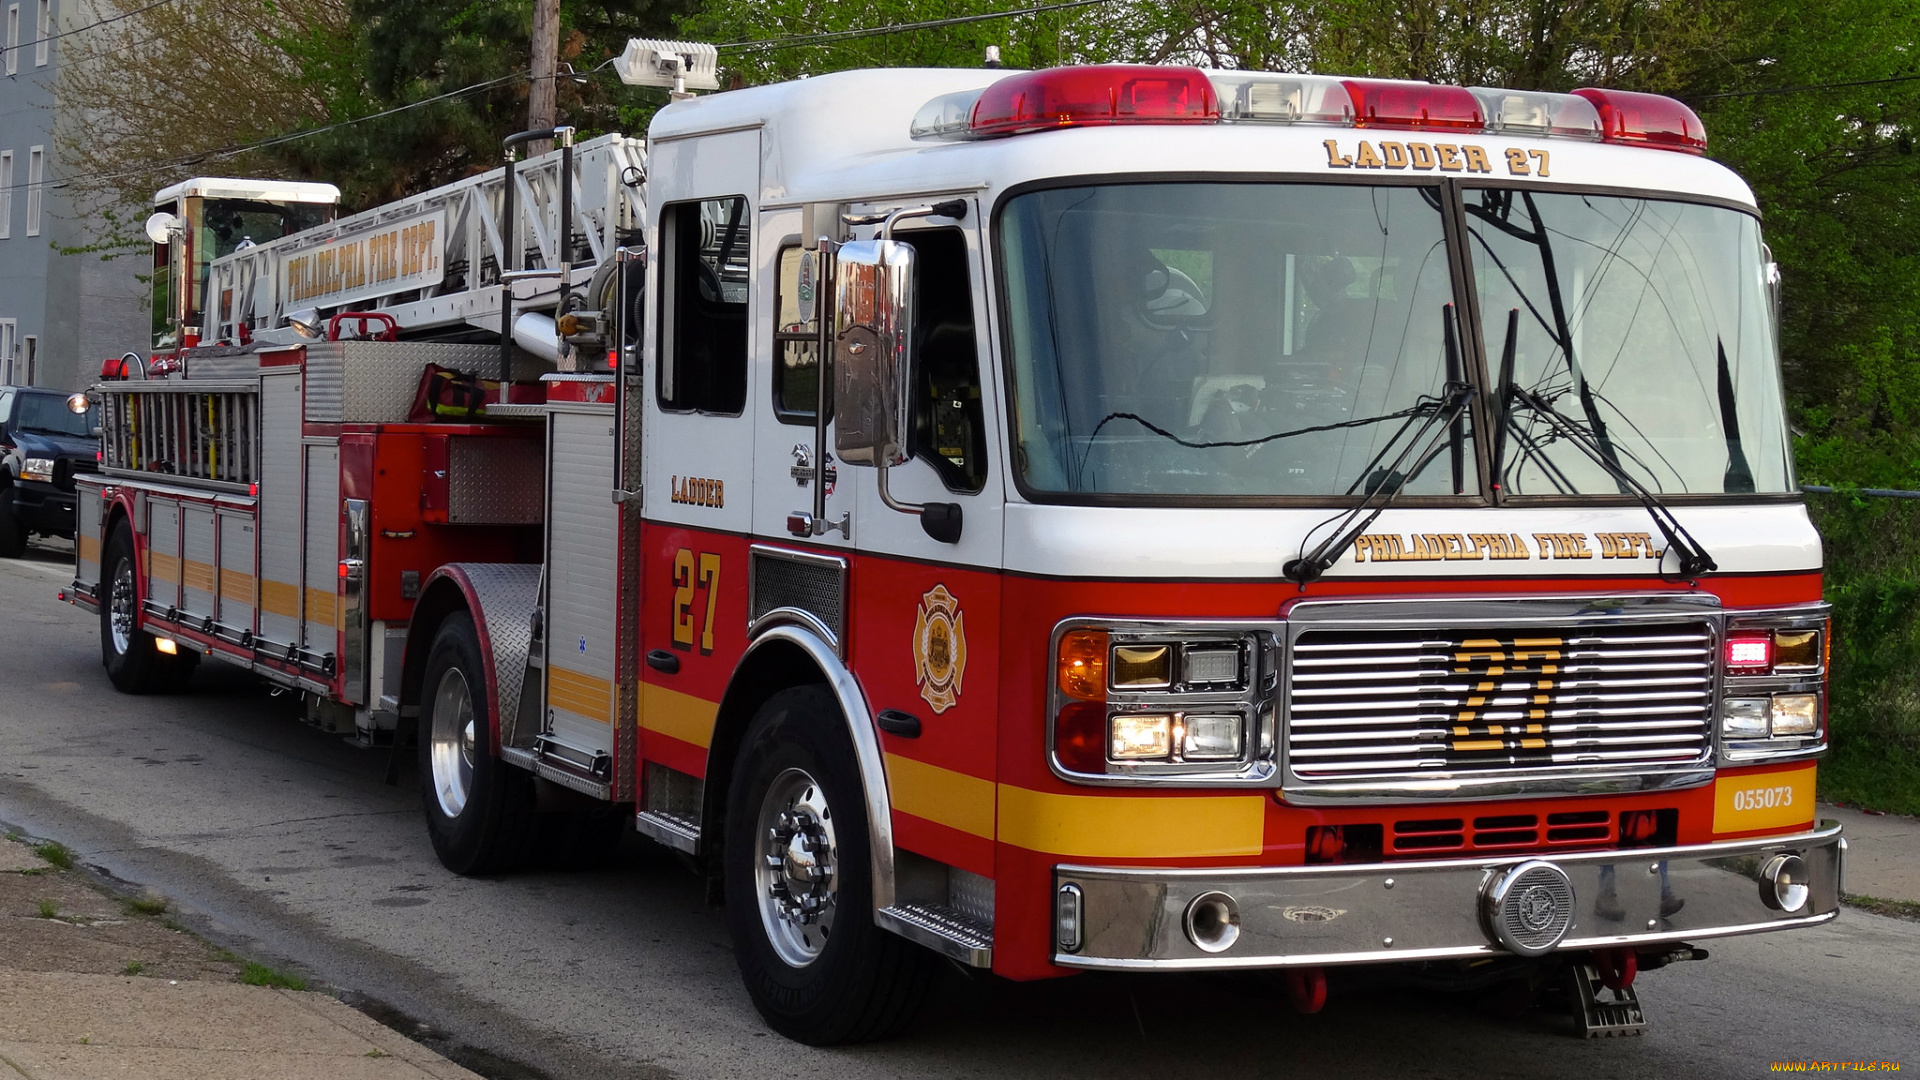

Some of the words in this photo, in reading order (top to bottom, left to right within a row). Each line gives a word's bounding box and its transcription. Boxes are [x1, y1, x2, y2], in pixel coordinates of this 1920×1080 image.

[1323, 139, 1492, 173] LADDER
[1505, 147, 1551, 178] 27
[288, 241, 365, 303] PHILADELPHIA
[369, 230, 398, 285] FIRE
[402, 219, 438, 277] DEPT.
[671, 475, 724, 508] LADDER
[1353, 533, 1530, 562] PHILADELPHIA
[1532, 533, 1592, 559] FIRE
[1595, 532, 1662, 559] DEPT.
[672, 548, 721, 655] 27
[1451, 637, 1564, 752] 27
[548, 709, 555, 732] 2
[1734, 786, 1793, 811] 055073
